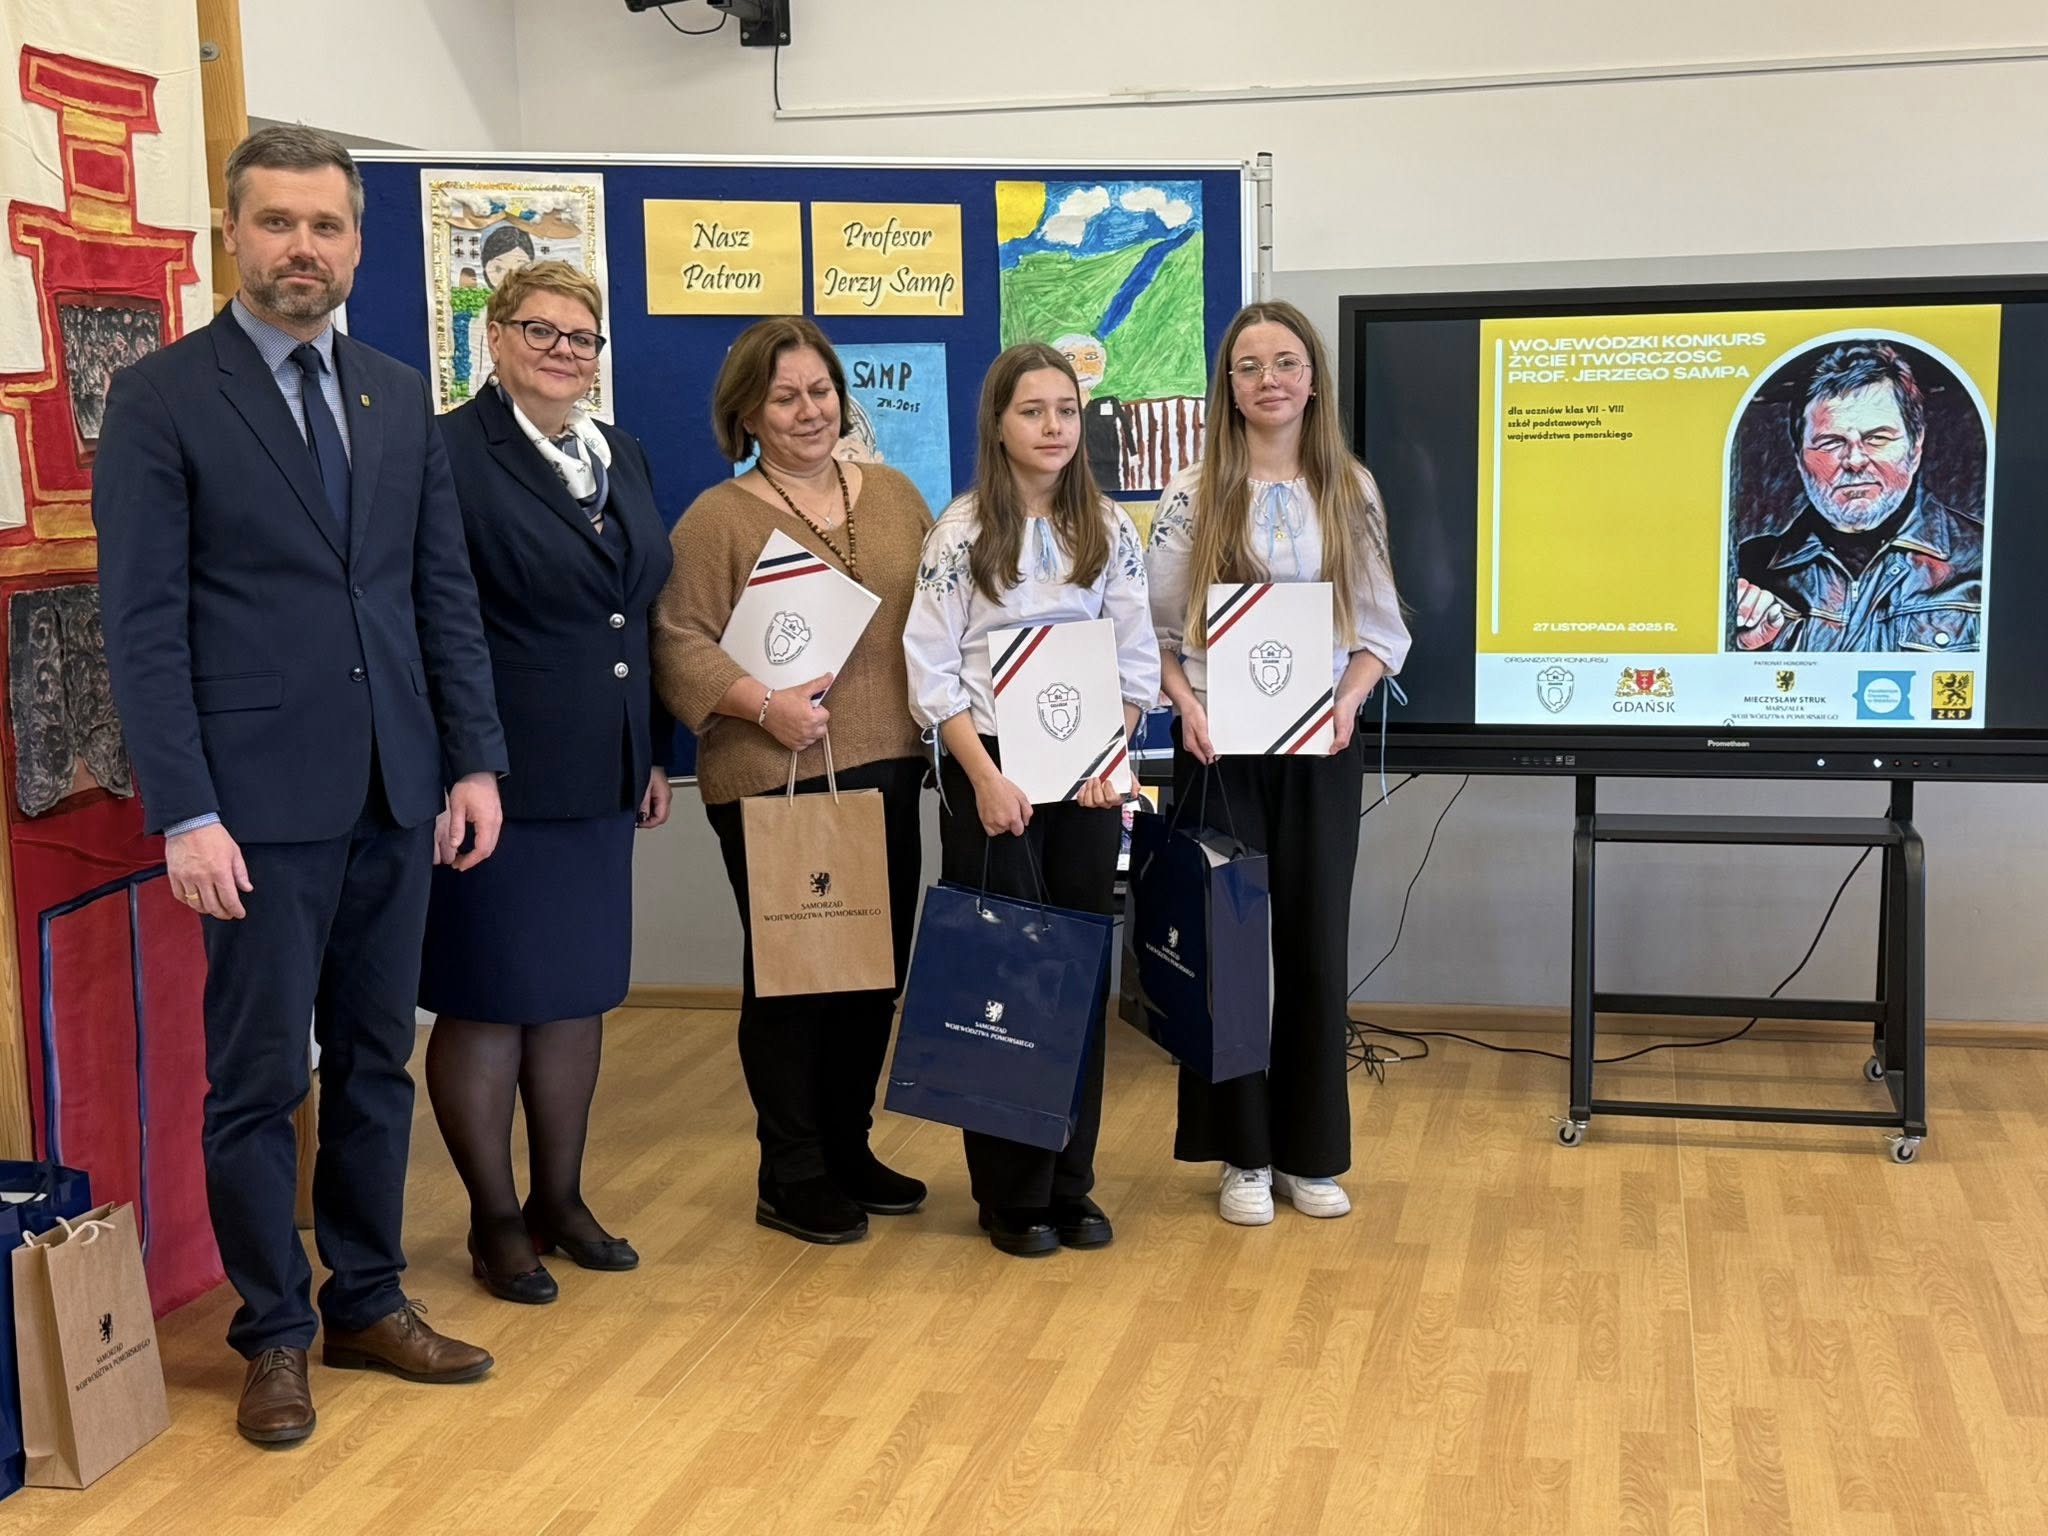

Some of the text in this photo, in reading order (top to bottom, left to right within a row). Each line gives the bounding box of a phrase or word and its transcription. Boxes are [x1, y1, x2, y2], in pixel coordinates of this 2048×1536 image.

[694, 223, 750, 248] Nasz
[844, 217, 933, 255] Profesor
[683, 264, 762, 289] Patron
[824, 267, 955, 307] Jerzy Samp
[1509, 333, 1767, 351] WOJEWÓDZKI KONKURS
[1509, 351, 1567, 368] ŻYCIE
[1570, 354, 1576, 366] I
[852, 361, 912, 391] SAMP
[1508, 365, 1750, 384] PROF. JERZEGO SAMPA
[1507, 406, 1523, 415] dla
[1525, 406, 1563, 415] uczniów
[1565, 405, 1584, 414] klas
[1586, 405, 1599, 414] VII
[1608, 405, 1625, 413] VIII
[1507, 418, 1602, 429] szkół podstawowych
[1507, 430, 1633, 442] województwa pomorskiego
[1533, 622, 1678, 632] 27 LISTOPADA 2025 R.
[1504, 656, 1563, 664] ORGANIZATOR
[1613, 699, 1675, 712] GDAŃSK
[825, 908, 881, 918] POMORSKIEGO
